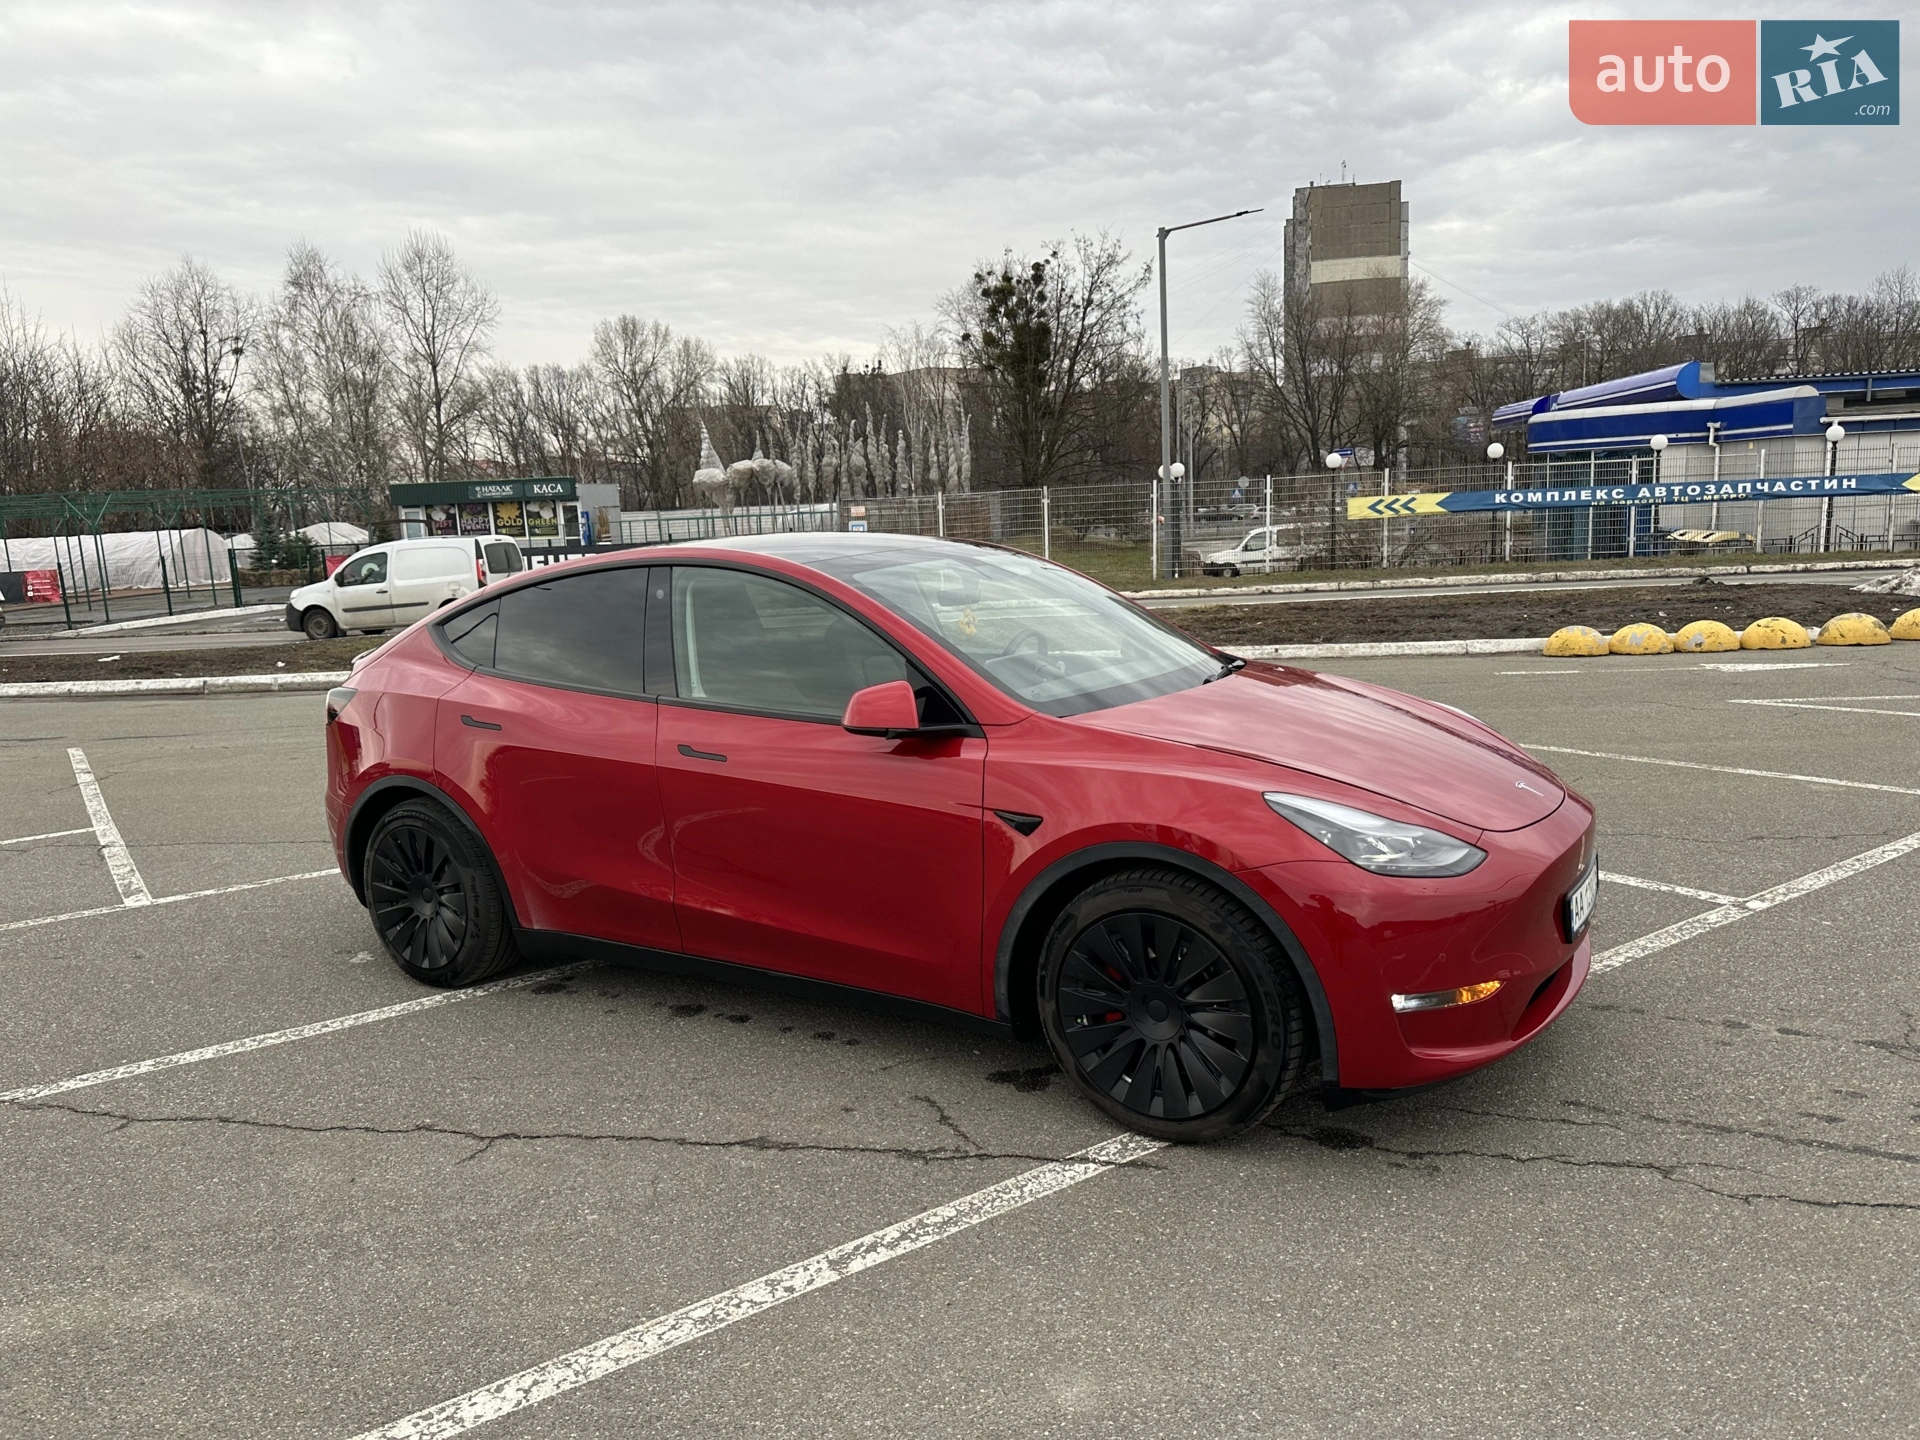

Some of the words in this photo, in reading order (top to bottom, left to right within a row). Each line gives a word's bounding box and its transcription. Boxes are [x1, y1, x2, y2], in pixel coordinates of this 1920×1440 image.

[533, 483, 564, 494] КАСА
[1495, 488, 1625, 503] КОМПЛЕКС
[1638, 478, 1857, 498] АВТОЗАПЧАСТИН
[1611, 497, 1666, 505] парковці
[461, 517, 489, 526] HAPPY
[496, 518, 523, 527] GOLD
[528, 517, 558, 526] GREEN
[461, 523, 490, 531] TWENTY
